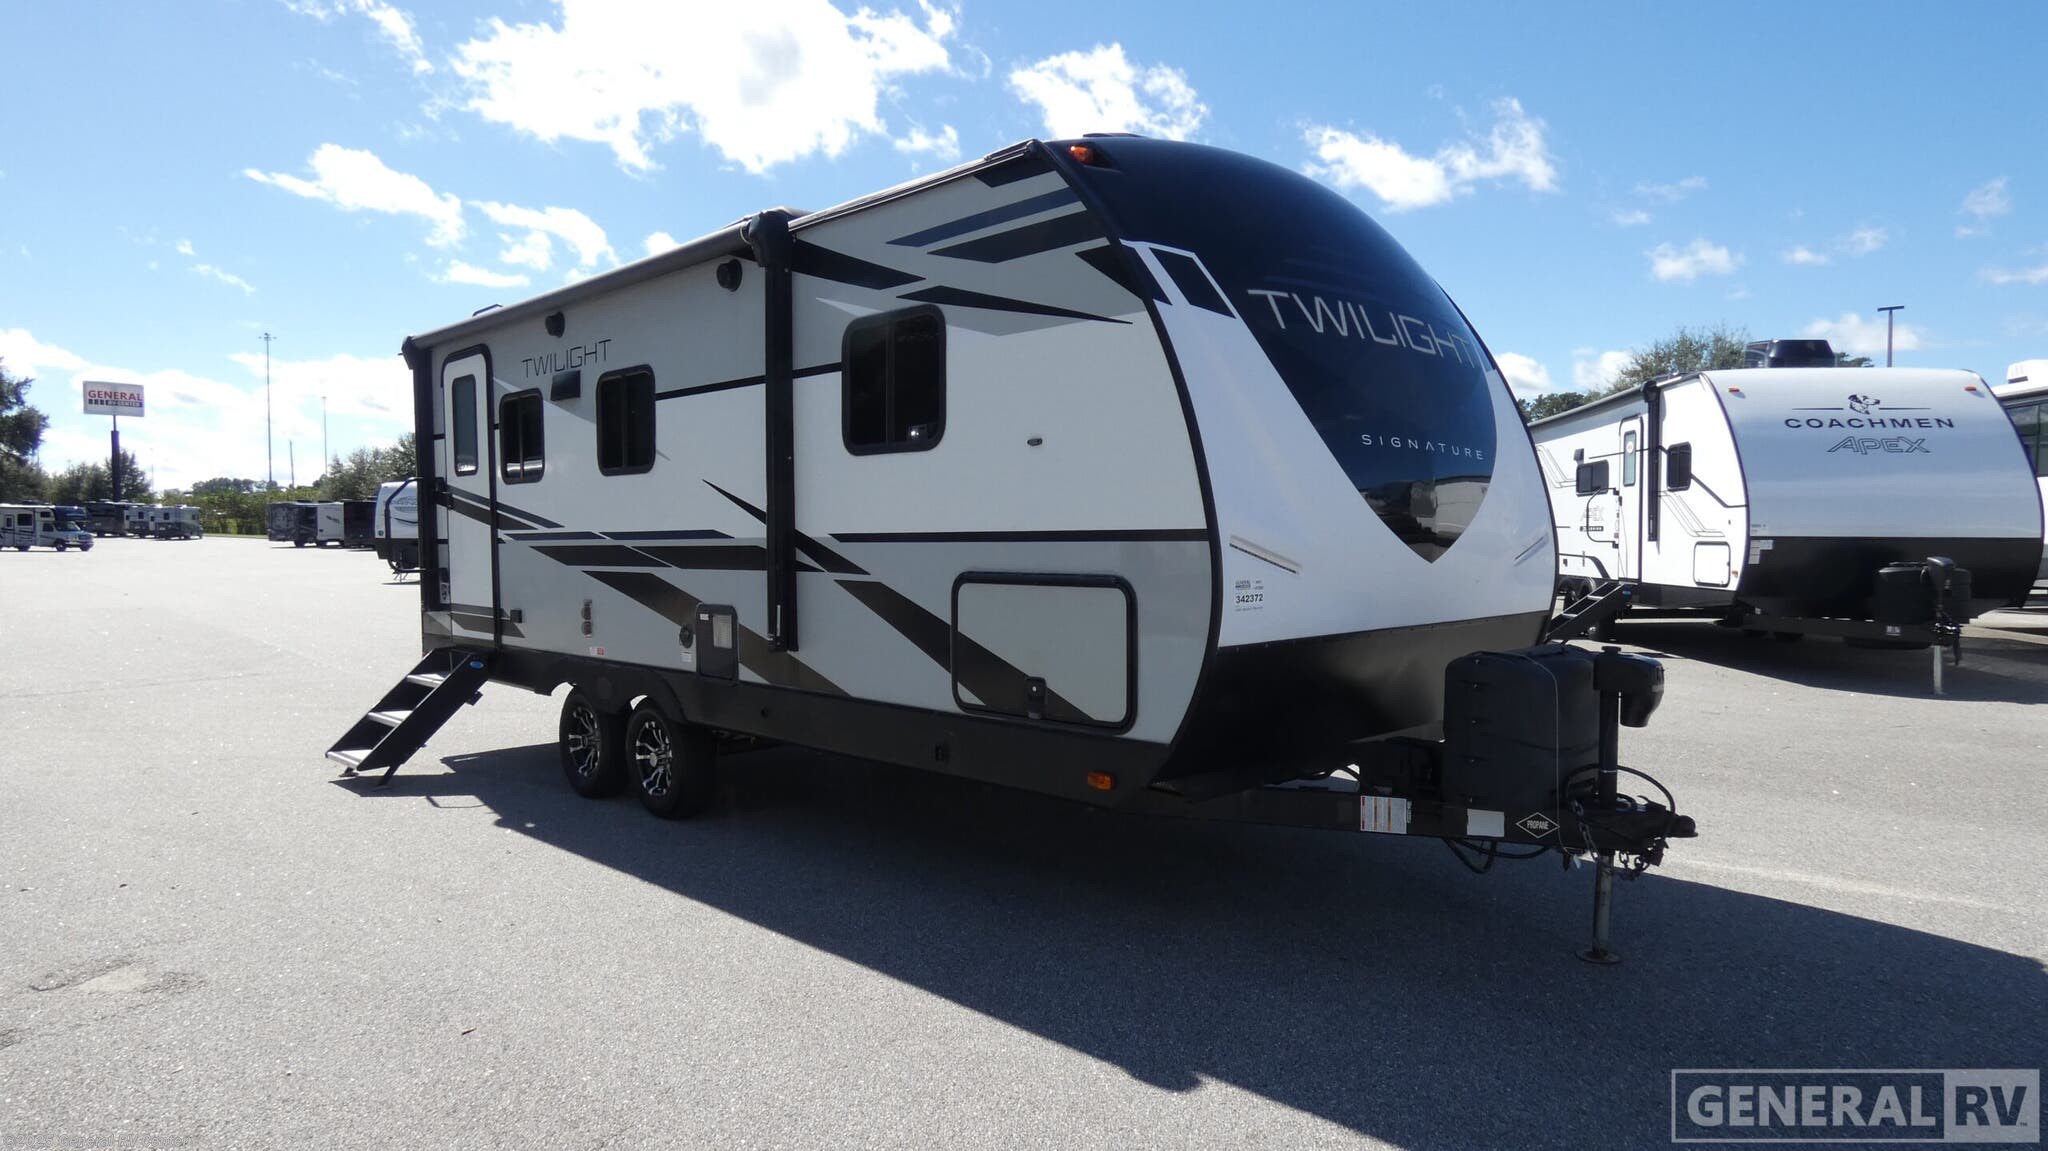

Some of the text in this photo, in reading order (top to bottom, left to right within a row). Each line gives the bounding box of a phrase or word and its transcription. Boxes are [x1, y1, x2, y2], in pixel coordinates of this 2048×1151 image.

[1247, 288, 1476, 369] TWILIGHT
[521, 338, 612, 378] TWILIGHT
[88, 390, 142, 401] GENERAL
[1784, 418, 1955, 429] COACHMEN
[1360, 434, 1484, 460] SIGNATURE
[1827, 435, 1931, 455] APEX
[1235, 594, 1264, 604] 342372
[1526, 819, 1549, 830] PROPANE
